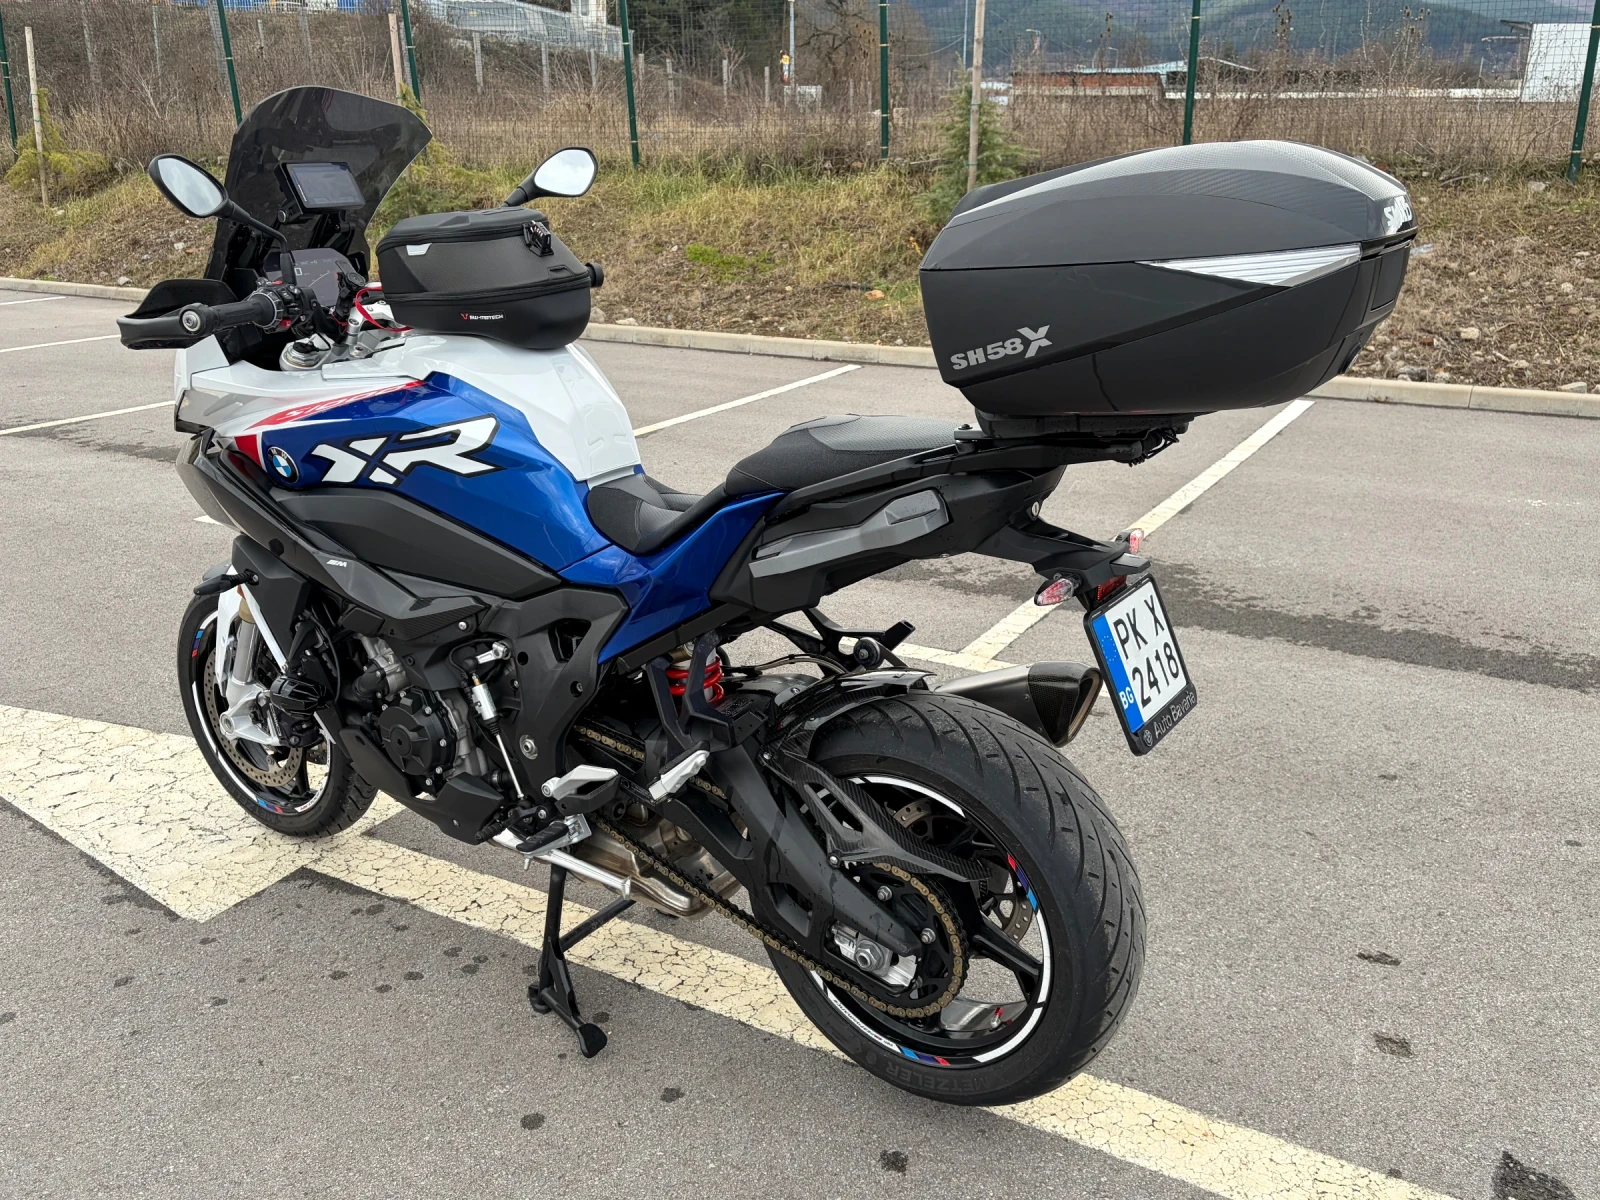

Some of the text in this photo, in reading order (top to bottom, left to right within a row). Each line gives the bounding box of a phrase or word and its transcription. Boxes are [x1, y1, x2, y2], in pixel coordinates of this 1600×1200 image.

[311, 415, 501, 486] XR
[1113, 595, 1165, 660] PK X
[1119, 686, 1135, 710] BG
[1131, 642, 1180, 709] 2418
[1153, 691, 1196, 739] Auto Bavaria
[885, 1061, 992, 1092] METZELER
